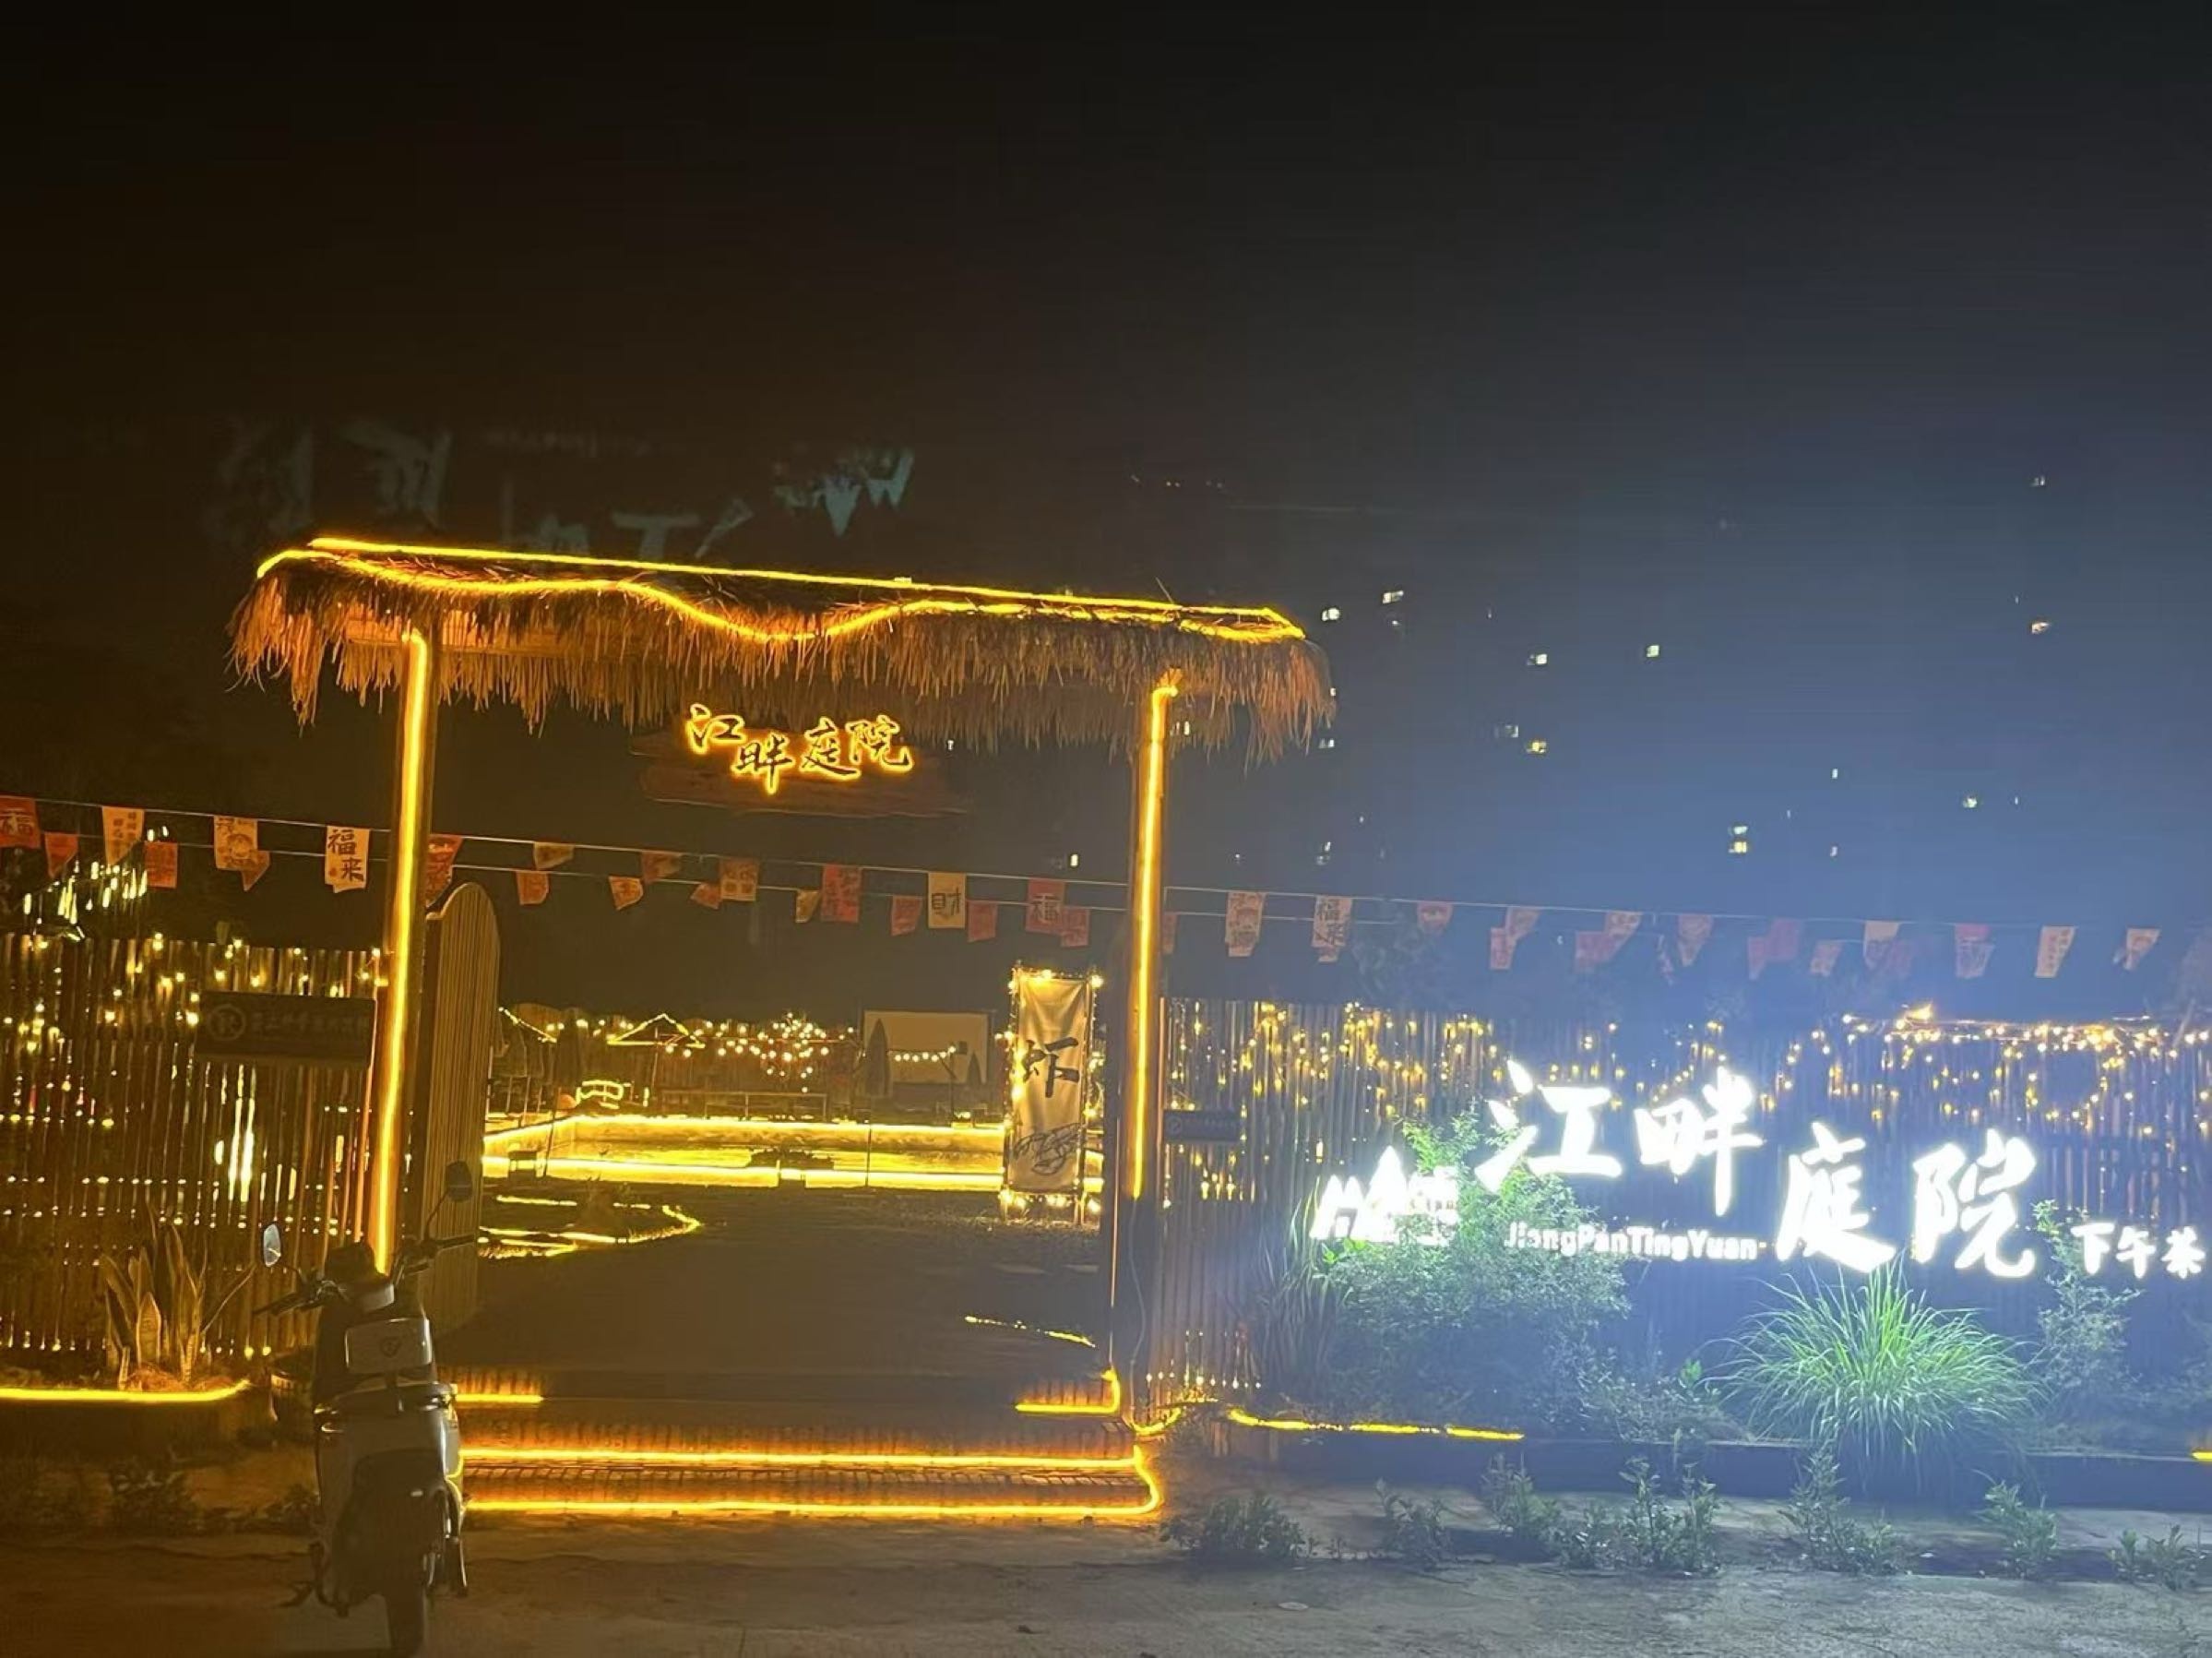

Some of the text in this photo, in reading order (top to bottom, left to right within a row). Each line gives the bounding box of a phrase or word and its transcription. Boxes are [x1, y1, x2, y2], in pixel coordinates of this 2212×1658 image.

[686, 703, 912, 795] 江畔庭院
[327, 829, 364, 882] 福来
[1474, 1056, 2037, 1278] 江畔庭院
[2069, 1222, 2206, 1280] 下午茶
